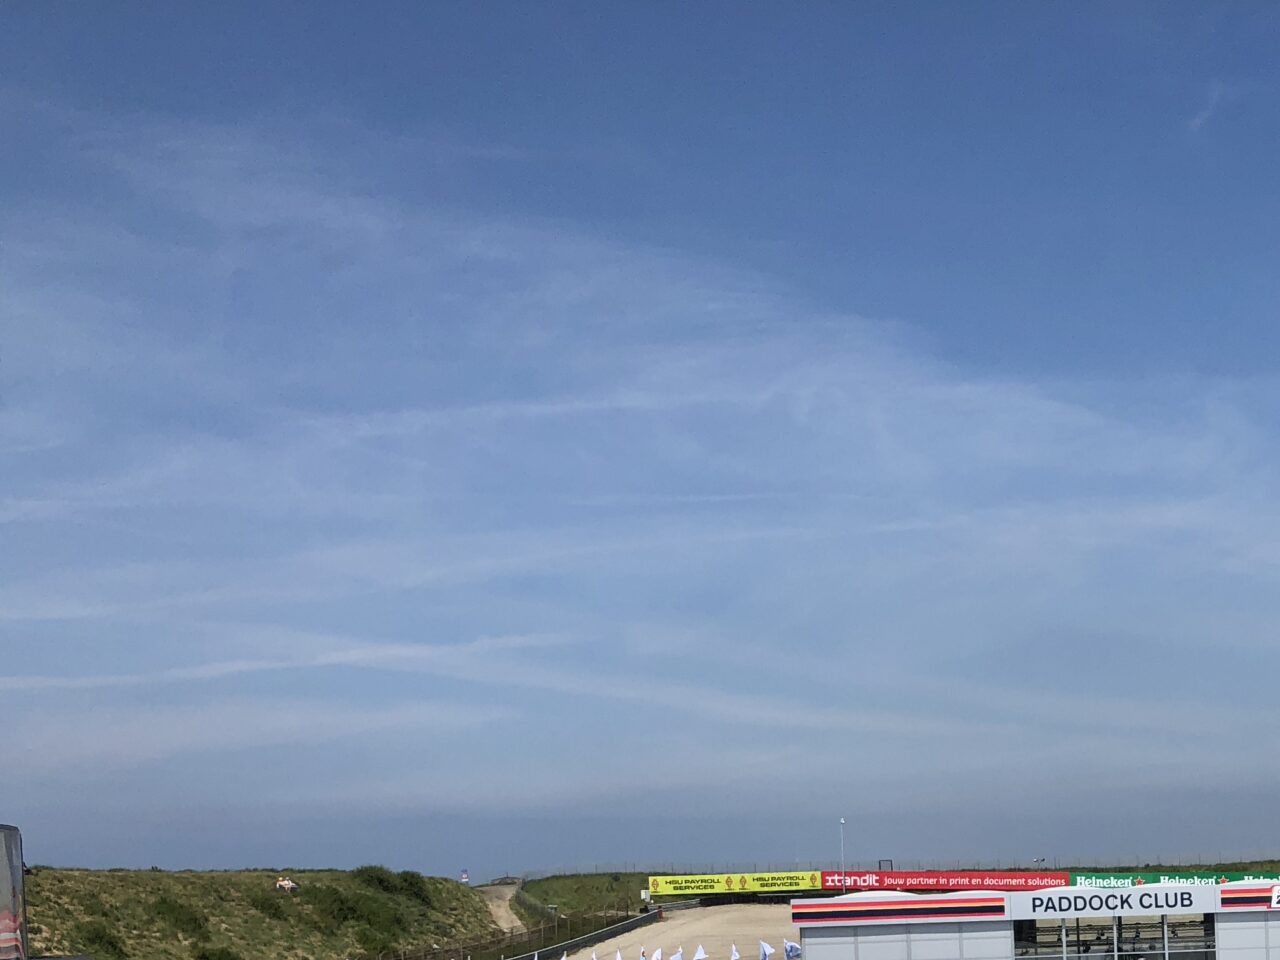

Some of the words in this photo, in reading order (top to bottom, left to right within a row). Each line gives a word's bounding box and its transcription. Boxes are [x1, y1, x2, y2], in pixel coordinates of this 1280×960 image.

[825, 874, 880, 886] xtandit
[883, 876, 904, 886] jouw
[906, 876, 938, 886] partner
[938, 876, 947, 885] in
[949, 876, 970, 886] print
[982, 876, 1025, 886] document
[1026, 876, 1064, 886] solutions
[1076, 876, 1132, 888] Heineken
[1160, 876, 1216, 886] Heineken
[1032, 894, 1133, 912] PADDOCK
[1139, 892, 1193, 909] CLUB
